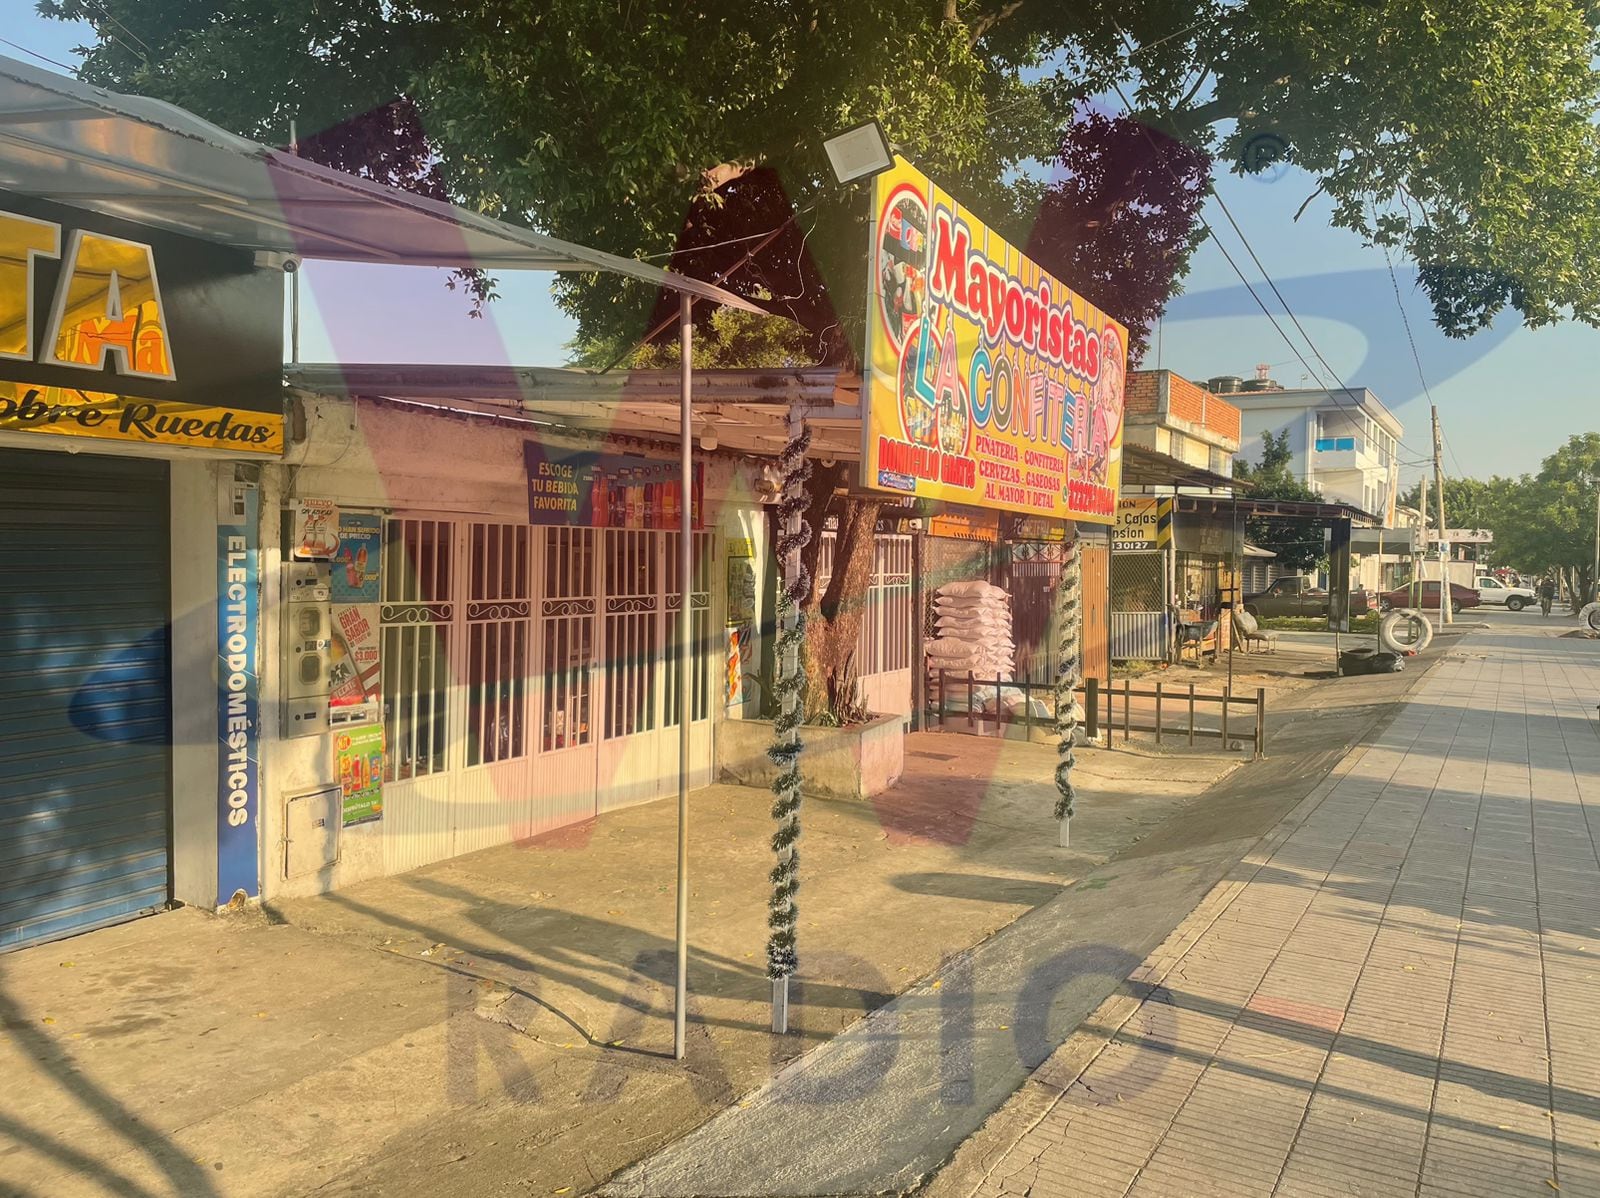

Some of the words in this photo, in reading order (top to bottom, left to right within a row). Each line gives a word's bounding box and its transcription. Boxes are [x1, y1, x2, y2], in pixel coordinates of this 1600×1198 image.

[930, 209, 1101, 382] Mayoristas
[914, 315, 961, 411] LA
[970, 348, 1107, 459] CONFITERIA
[118, 403, 276, 445] Ruedas
[878, 435, 940, 483] DOMICILIO
[940, 451, 976, 490] GRATIS
[975, 433, 1019, 462] PIÑATERIA
[1024, 445, 1065, 473] CONFITERIA
[538, 461, 573, 479] ESCOGE
[978, 459, 1021, 483] CERVEZAS
[1025, 470, 1061, 492] GASEOSAS
[532, 478, 545, 493] TU
[545, 479, 579, 496] BEBIDA
[984, 483, 996, 500] AL
[997, 484, 1026, 504] MAYOR
[1025, 492, 1033, 505] Y
[1033, 492, 1055, 509] DETAL
[533, 496, 577, 512] FAVORITA
[1124, 512, 1157, 526] Cajas
[339, 607, 361, 629] GRAN
[344, 618, 370, 642] SABOR
[227, 534, 252, 828] ELECTRODOMÉSTICOS
